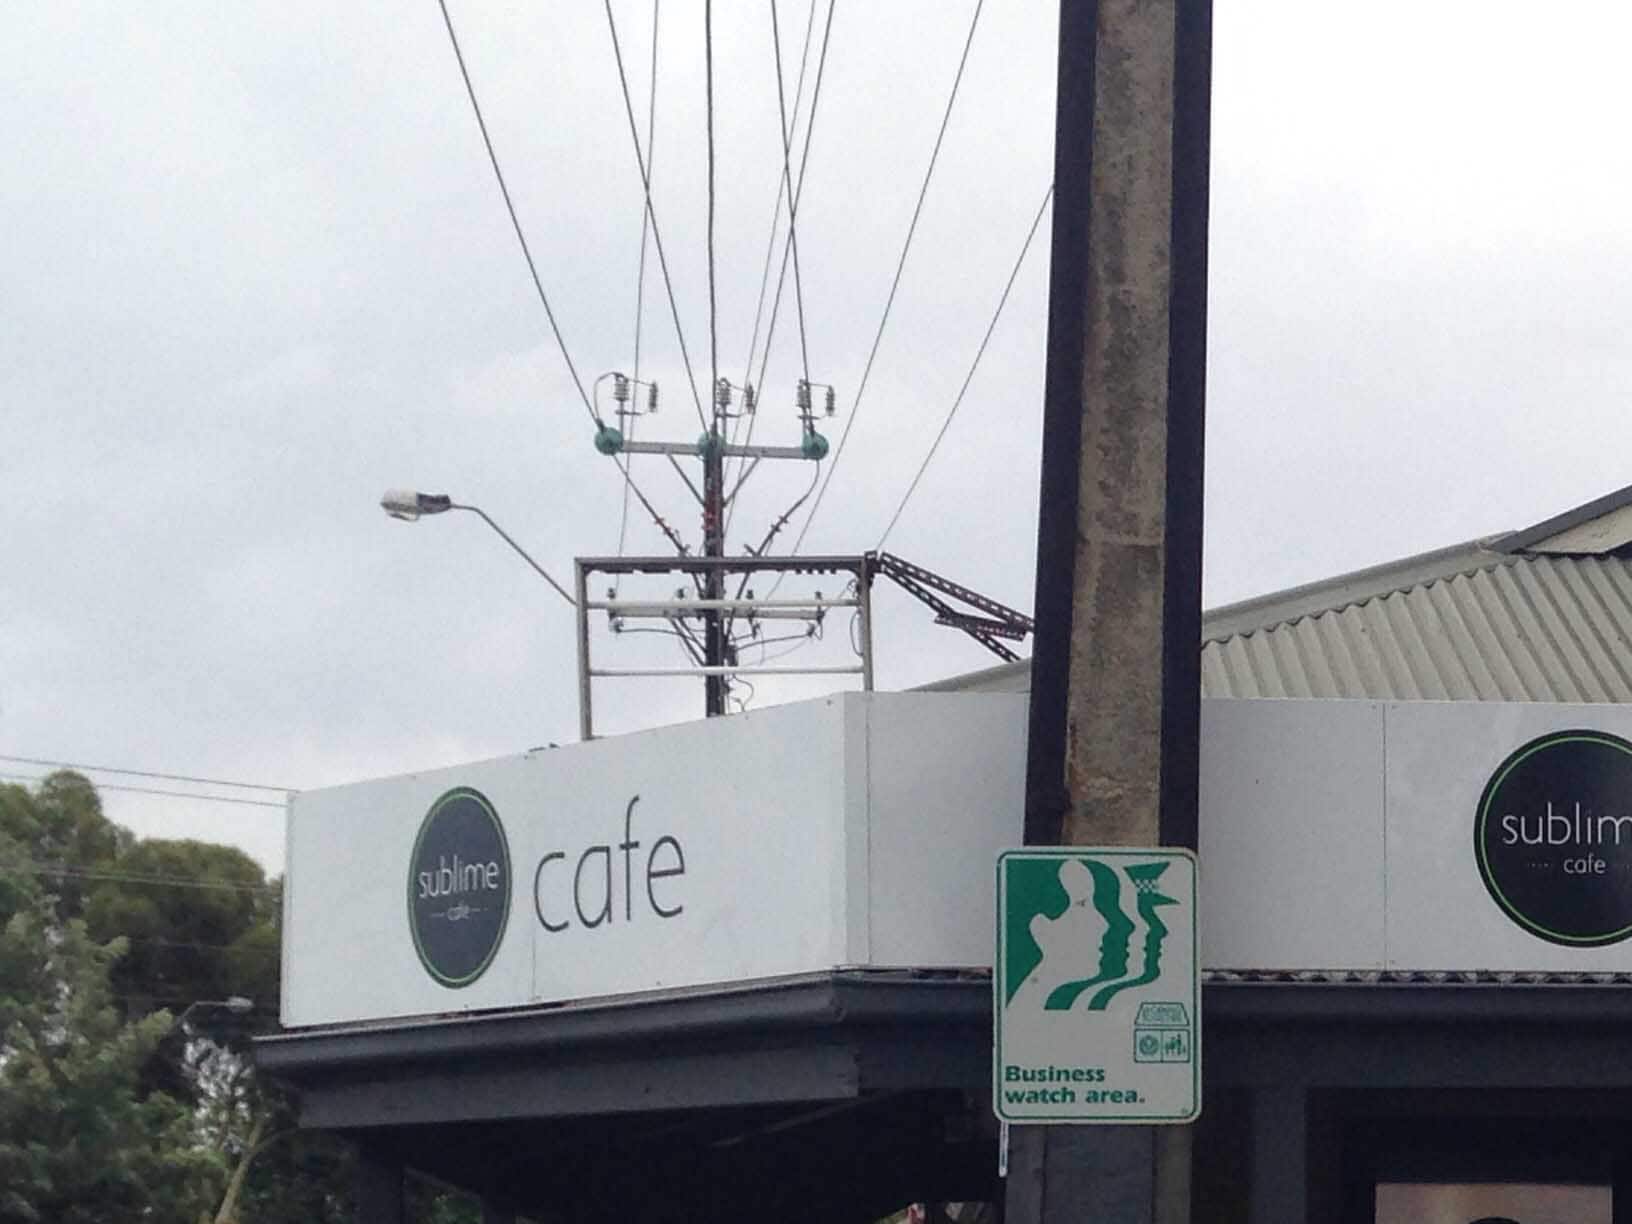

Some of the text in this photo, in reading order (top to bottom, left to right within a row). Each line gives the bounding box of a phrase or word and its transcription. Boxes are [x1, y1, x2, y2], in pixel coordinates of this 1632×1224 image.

[534, 795, 685, 932] cafe
[1563, 852, 1606, 874] cafe
[418, 855, 499, 898] sublime
[1005, 1065, 1105, 1082] Business
[1005, 1087, 1145, 1104] watch area.
